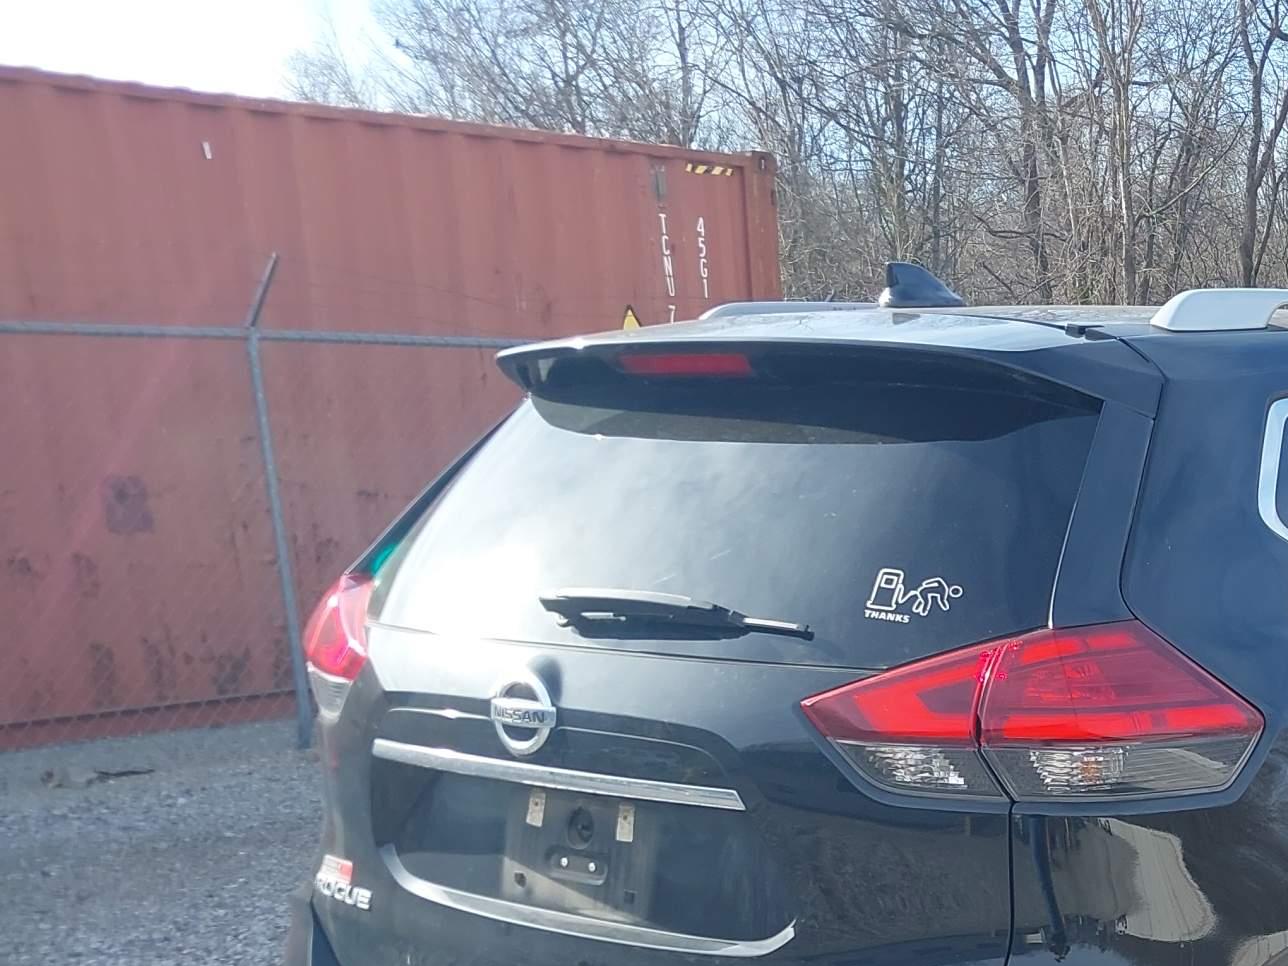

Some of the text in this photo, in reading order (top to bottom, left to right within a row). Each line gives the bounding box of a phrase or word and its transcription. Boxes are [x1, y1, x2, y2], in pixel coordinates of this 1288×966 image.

[658, 213, 675, 296] TCNU
[697, 217, 709, 299] 45G1
[864, 609, 910, 623] THANKS
[495, 706, 545, 723] NISSAN
